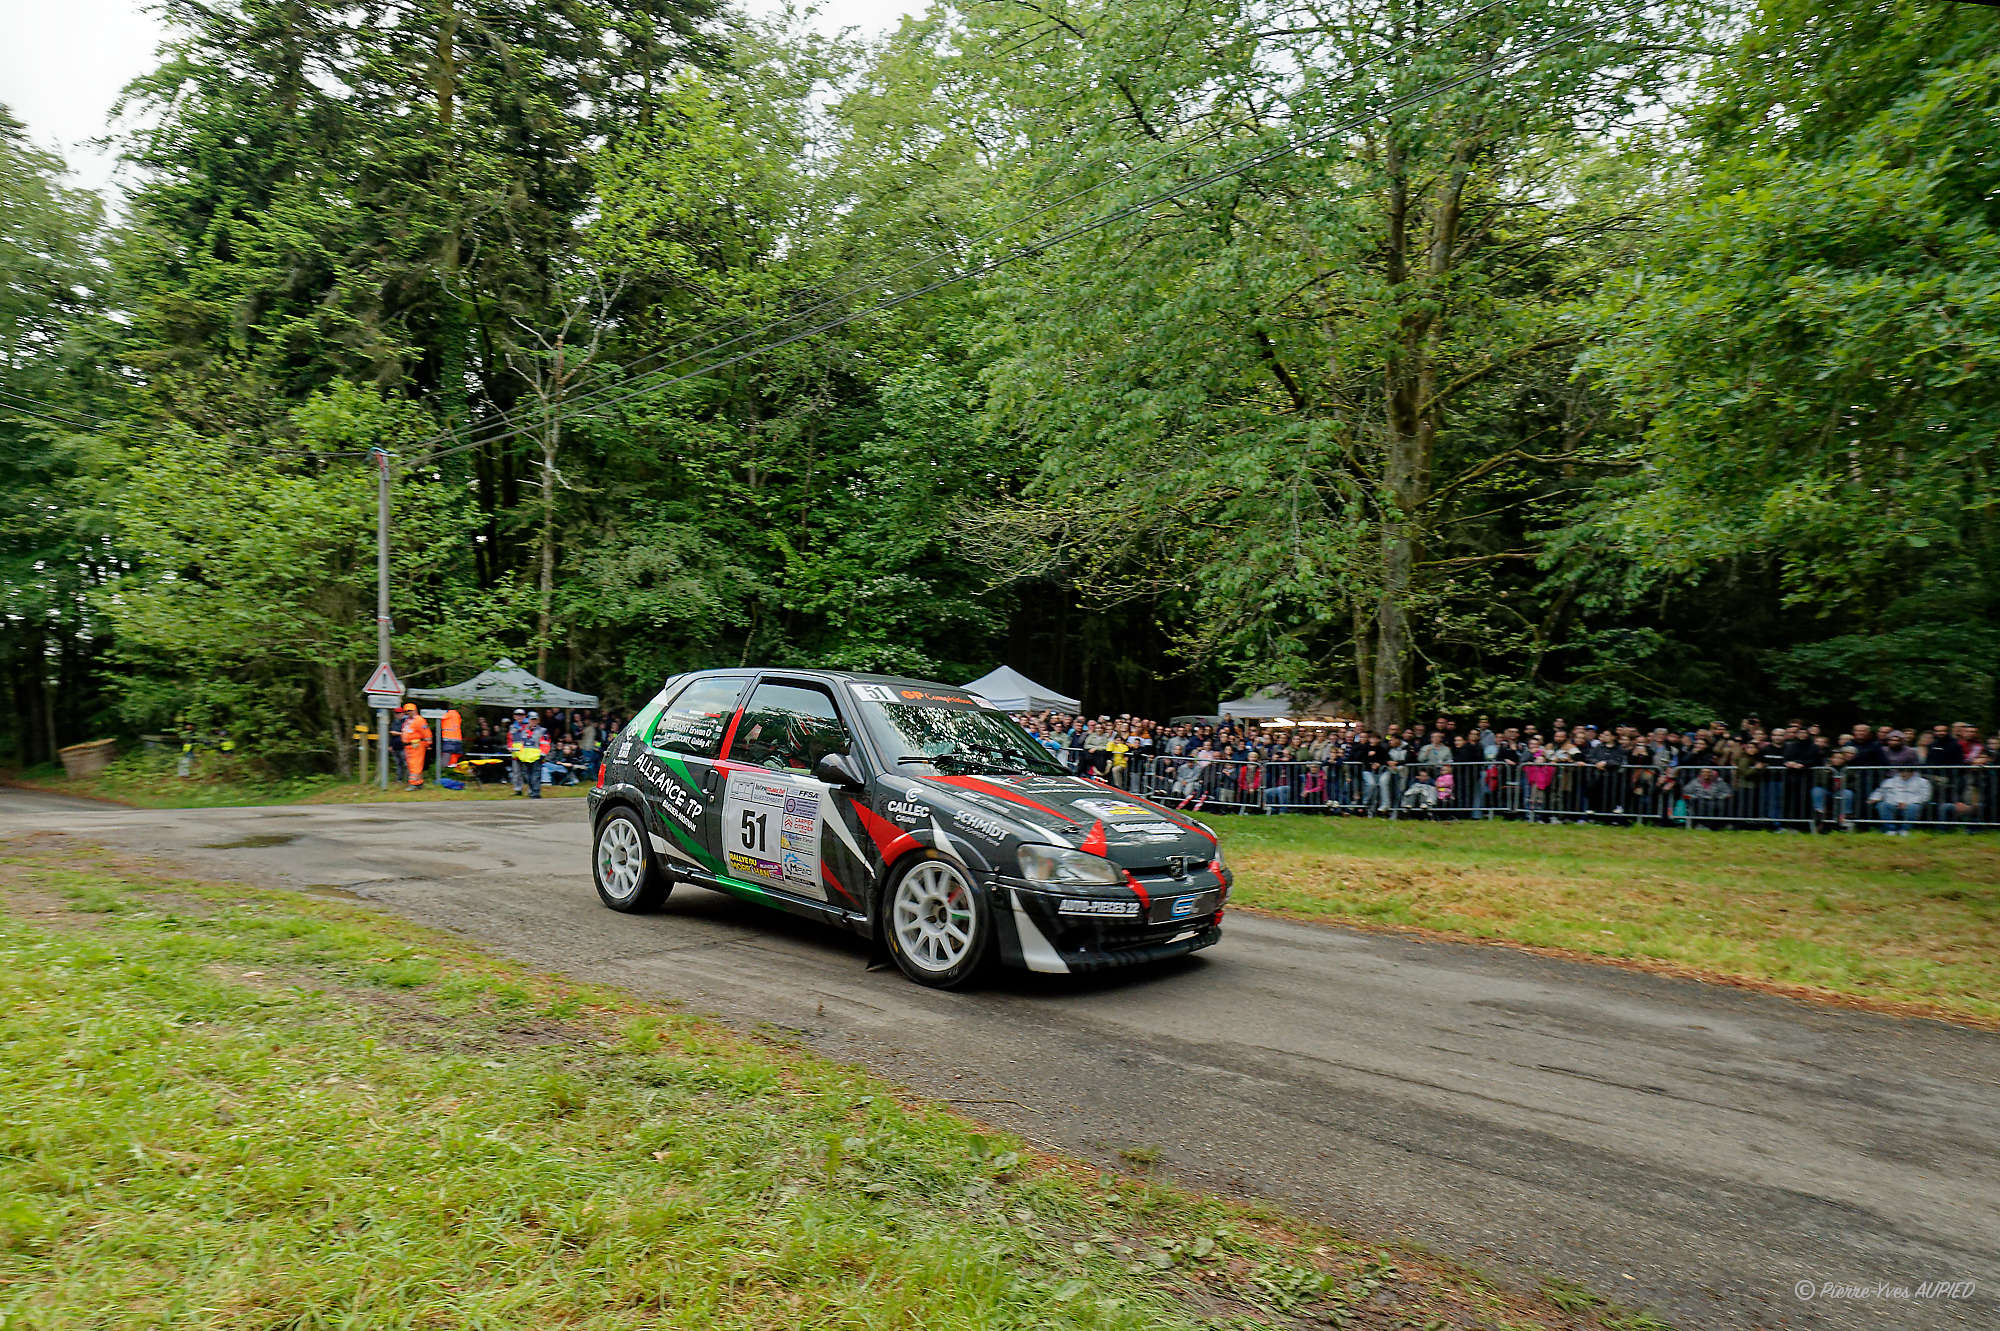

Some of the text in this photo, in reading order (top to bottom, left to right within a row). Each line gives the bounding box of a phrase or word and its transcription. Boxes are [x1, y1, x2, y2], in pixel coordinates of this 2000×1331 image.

[862, 685, 889, 700] 51
[633, 753, 703, 819] ALLIANCE TP
[798, 790, 819, 799] FFSA
[887, 800, 930, 818] CALLEC
[741, 809, 767, 852] 51
[729, 852, 758, 866] RALLYE DU
[1126, 902, 1141, 914] 22
